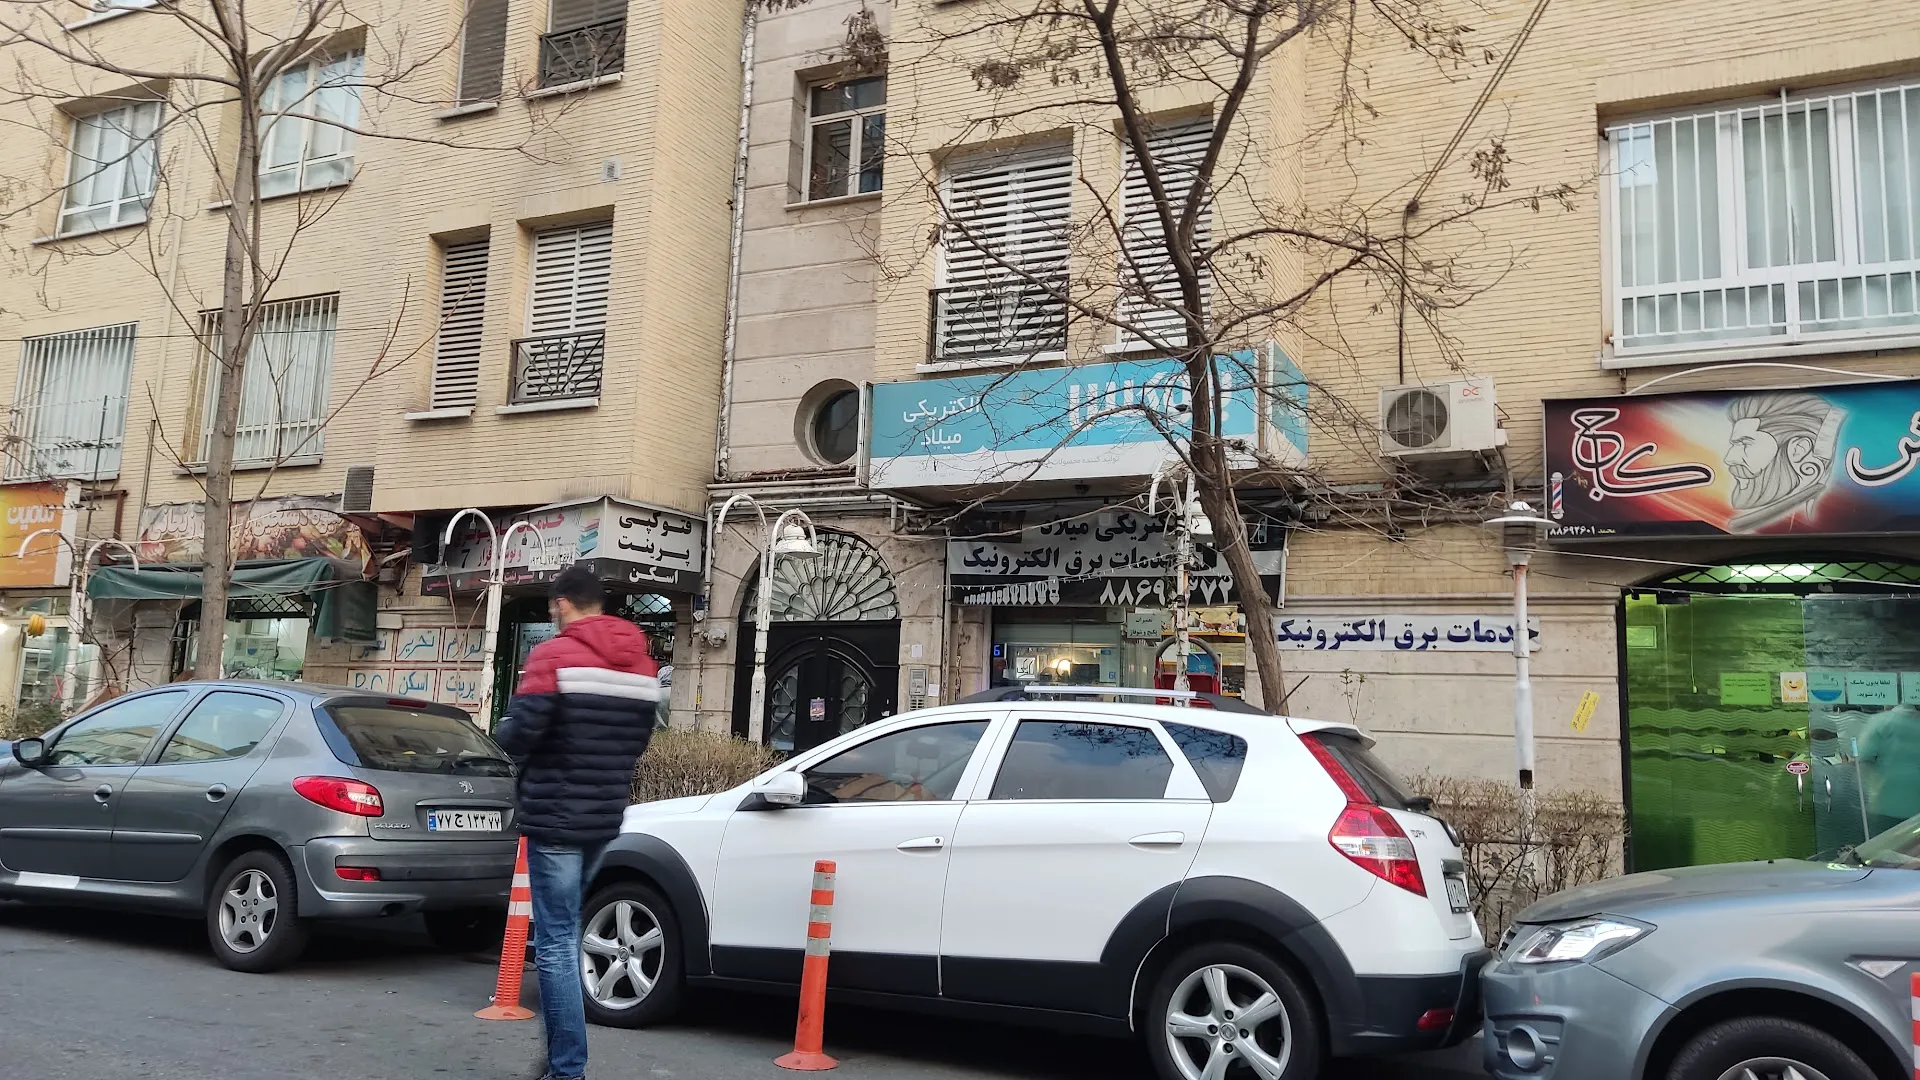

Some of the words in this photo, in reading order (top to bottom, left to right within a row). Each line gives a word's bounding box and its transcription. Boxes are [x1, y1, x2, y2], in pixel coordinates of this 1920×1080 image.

[903, 396, 981, 423] الکتریکی
[920, 428, 962, 450] میلاد
[617, 538, 690, 567] پرینت
[963, 546, 1060, 575] الکترونیک
[1065, 550, 1103, 576] برق
[628, 566, 679, 585] اسکن
[397, 630, 435, 660] تحریر
[1394, 622, 1439, 651] برق
